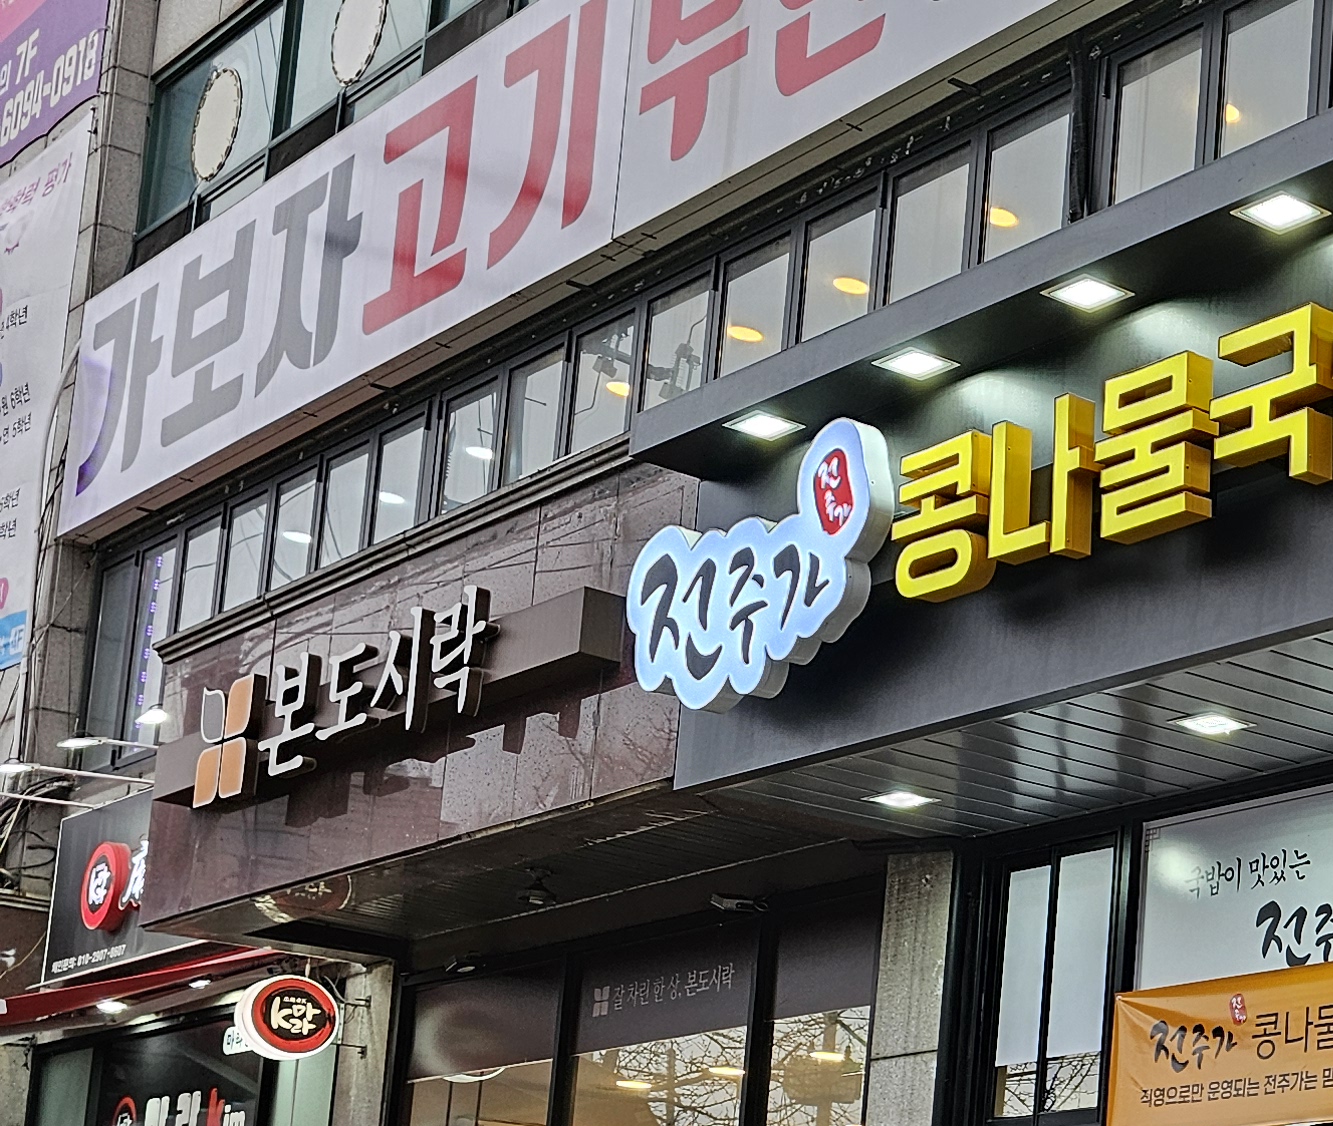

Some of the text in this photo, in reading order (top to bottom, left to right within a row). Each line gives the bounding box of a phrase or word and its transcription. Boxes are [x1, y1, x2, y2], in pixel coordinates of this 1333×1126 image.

[15, 28, 40, 85] 7F
[639, 545, 832, 679] 전주가
[257, 584, 489, 777] 본도시락
[1249, 847, 1312, 887] 맛있는
[1149, 1019, 1238, 1074] 전주가
[1139, 1084, 1205, 1108] 직영으로만
[1206, 1077, 1260, 1102] 운영되는
[1262, 1070, 1318, 1096] 전주가는
